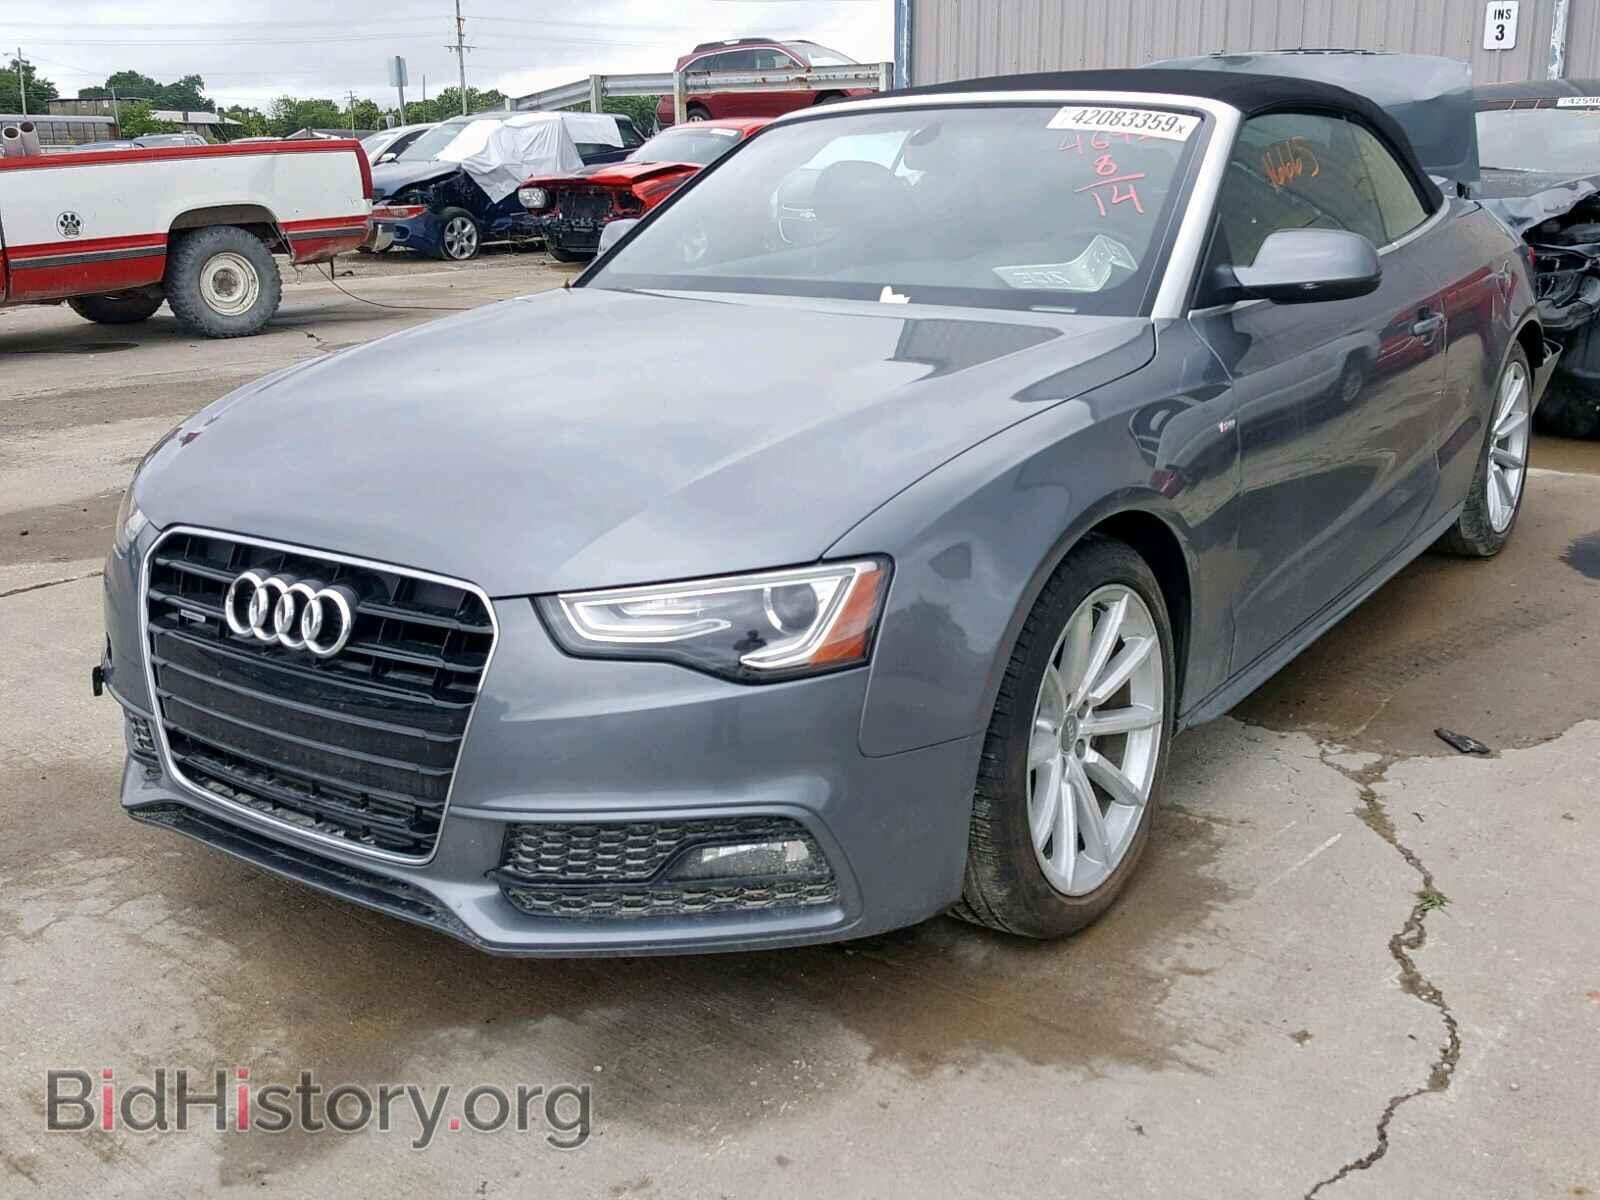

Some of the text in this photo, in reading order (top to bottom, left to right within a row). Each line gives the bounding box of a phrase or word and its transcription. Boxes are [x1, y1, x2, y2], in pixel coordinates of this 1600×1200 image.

[1493, 9, 1512, 20] INS
[1495, 24, 1505, 41] 3
[1071, 109, 1179, 132] 42083359
